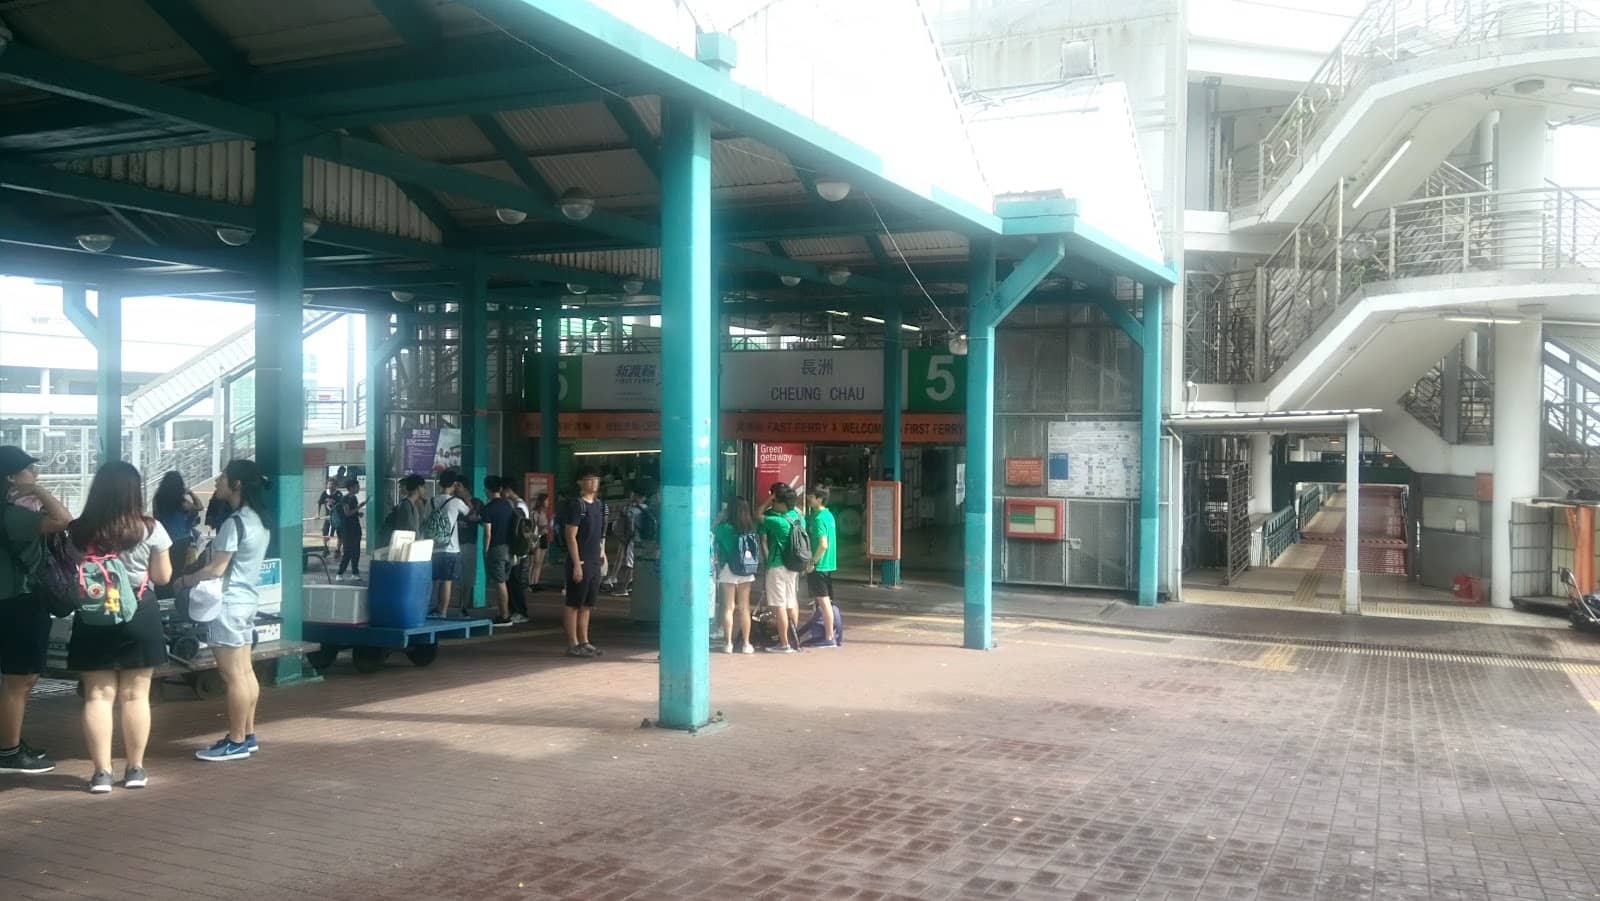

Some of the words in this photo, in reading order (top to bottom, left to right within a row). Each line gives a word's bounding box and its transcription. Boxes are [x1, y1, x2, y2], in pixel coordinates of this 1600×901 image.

[801, 358, 833, 376] 長洲
[925, 354, 956, 401] 5
[771, 386, 821, 401] CHEUNG
[830, 386, 865, 401] CHAU
[767, 421, 792, 433] FAST
[795, 421, 827, 433] FERRY
[841, 422, 885, 434] WELCOM
[904, 423, 931, 435] FIRST
[933, 423, 965, 436] FERRY
[760, 443, 783, 454] Green
[760, 453, 793, 464] getaway
